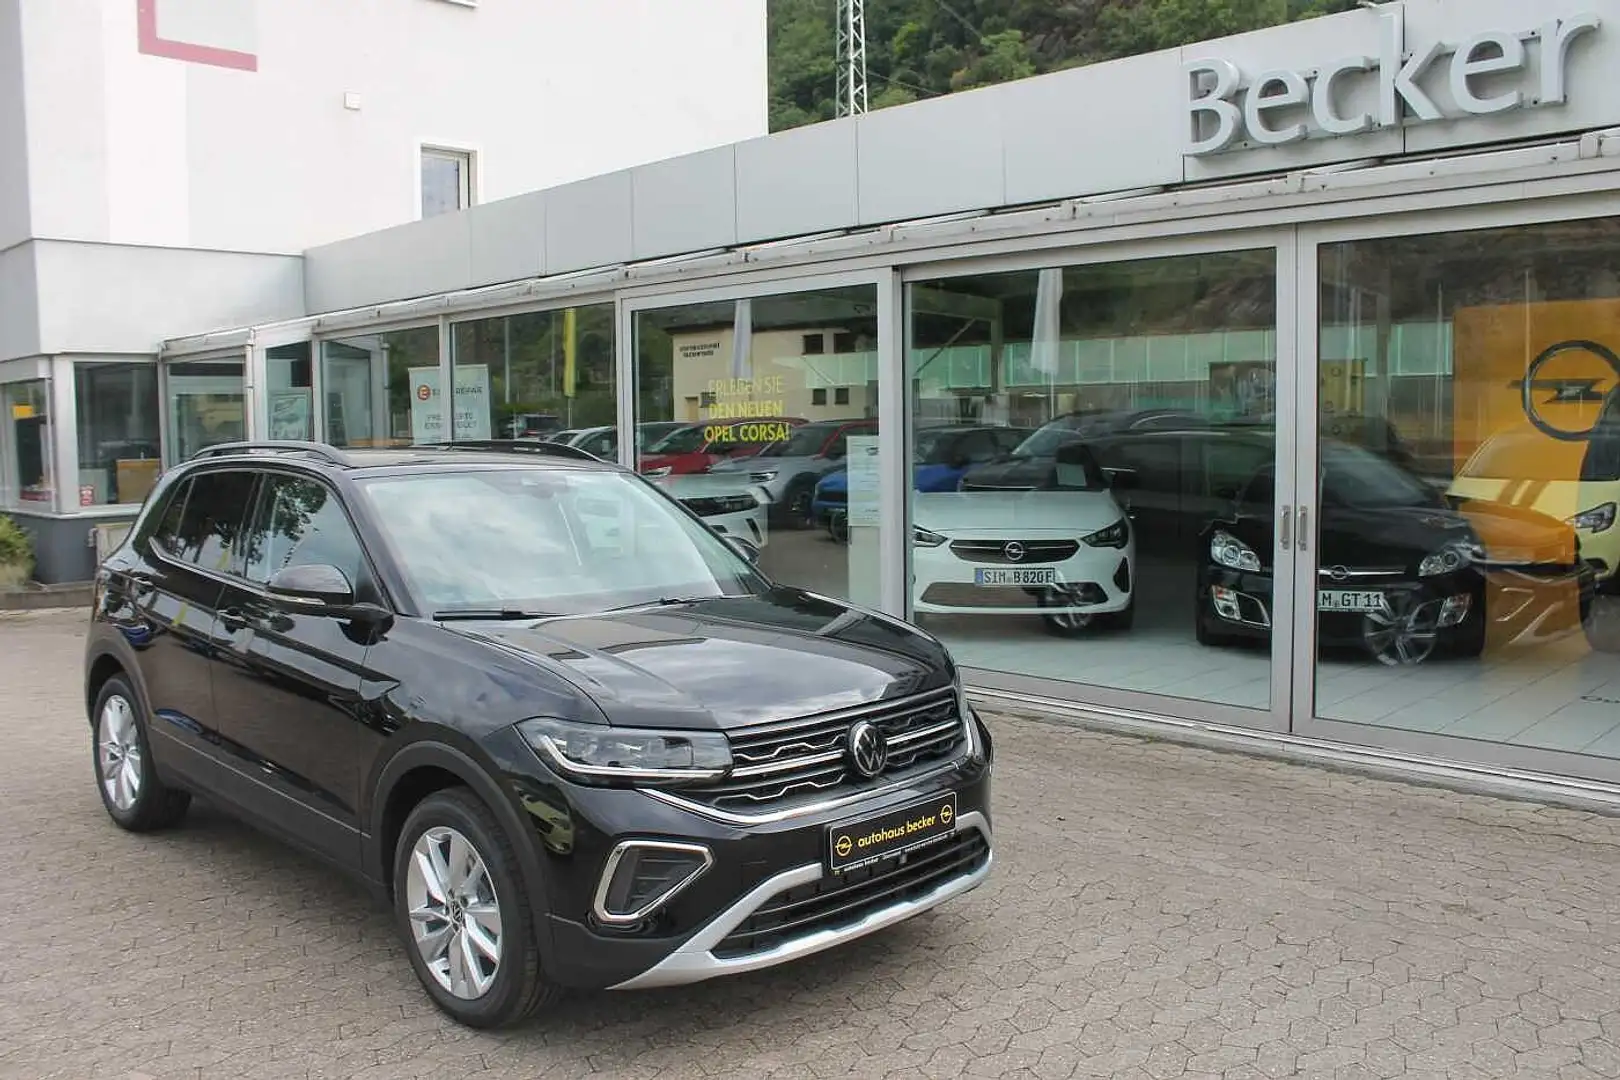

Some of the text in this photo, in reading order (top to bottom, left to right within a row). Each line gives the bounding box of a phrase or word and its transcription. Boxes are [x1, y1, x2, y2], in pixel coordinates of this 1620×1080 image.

[1182, 11, 1601, 158] Becker
[765, 376, 784, 394] SIE
[709, 400, 784, 418] DEN NEUEN
[704, 422, 790, 442] OPEL CORSA!
[1322, 592, 1332, 607] M
[857, 824, 905, 848] autohaus
[906, 815, 936, 834] becker
